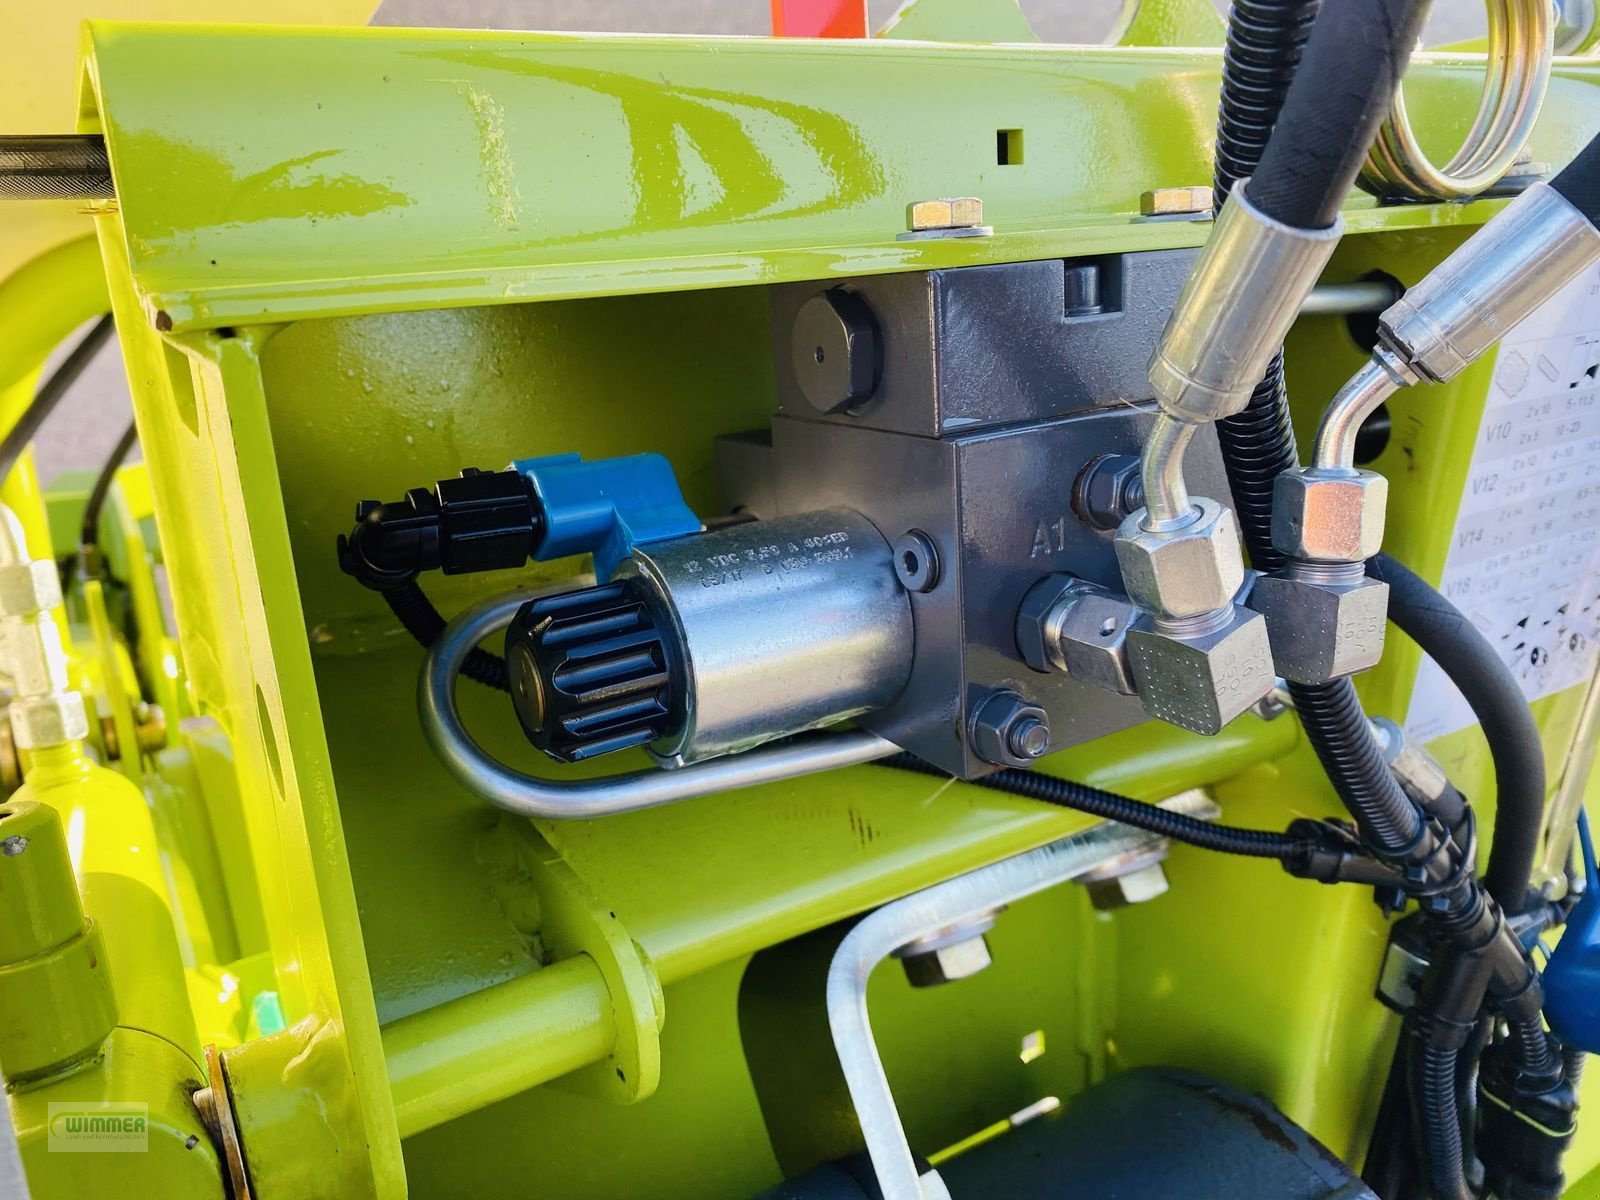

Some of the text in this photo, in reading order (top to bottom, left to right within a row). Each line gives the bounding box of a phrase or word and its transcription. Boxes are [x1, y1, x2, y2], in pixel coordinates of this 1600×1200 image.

[1486, 420, 1512, 441] V10
[1473, 473, 1498, 496] V12
[1029, 517, 1065, 559] A1
[1459, 527, 1484, 548] V14
[1447, 577, 1472, 598] V18
